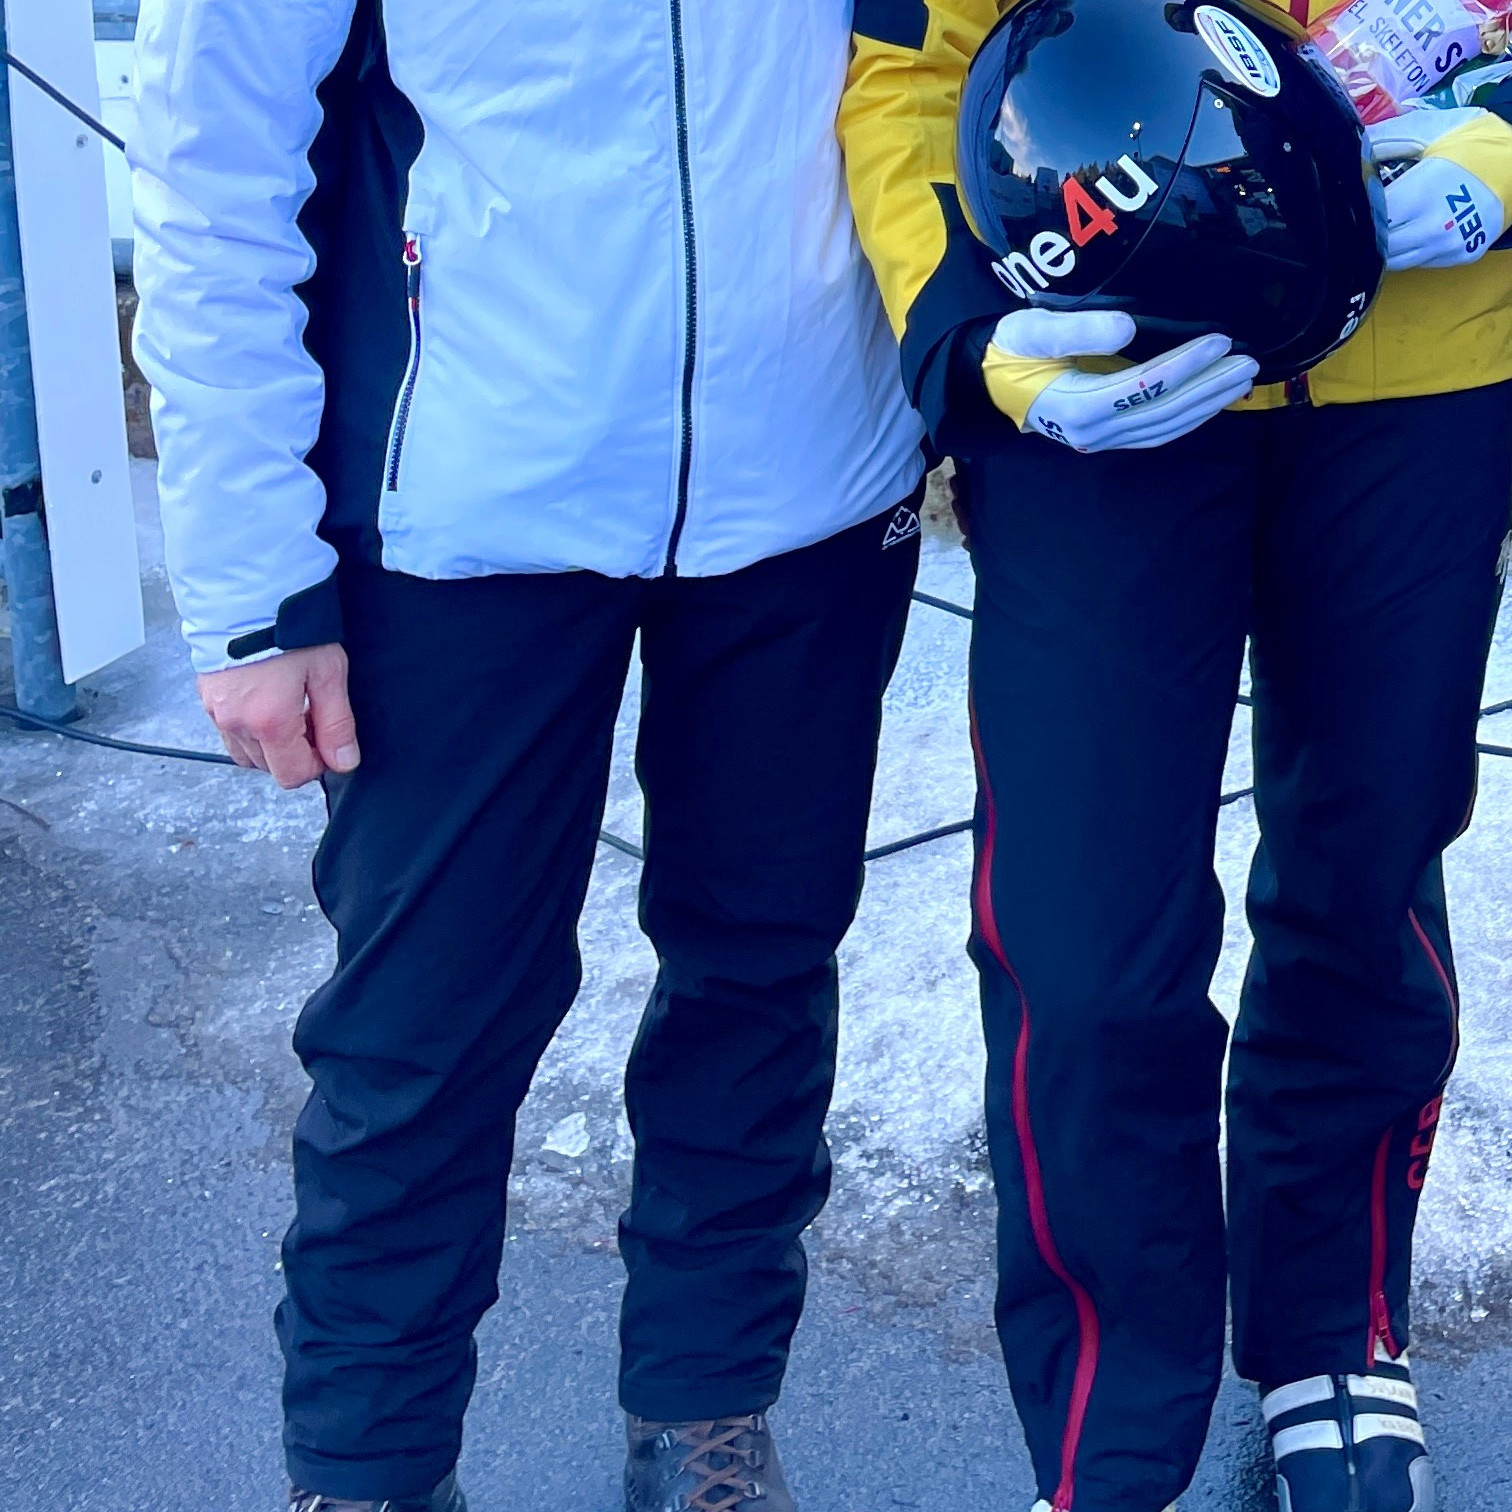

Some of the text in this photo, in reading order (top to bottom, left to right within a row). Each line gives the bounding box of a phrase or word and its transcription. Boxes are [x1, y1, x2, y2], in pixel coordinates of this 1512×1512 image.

[1215, 19, 1262, 79] IBSF
[1369, 16, 1431, 93] SKELETON
[1434, 41, 1468, 74] S
[991, 153, 1159, 299] one4u
